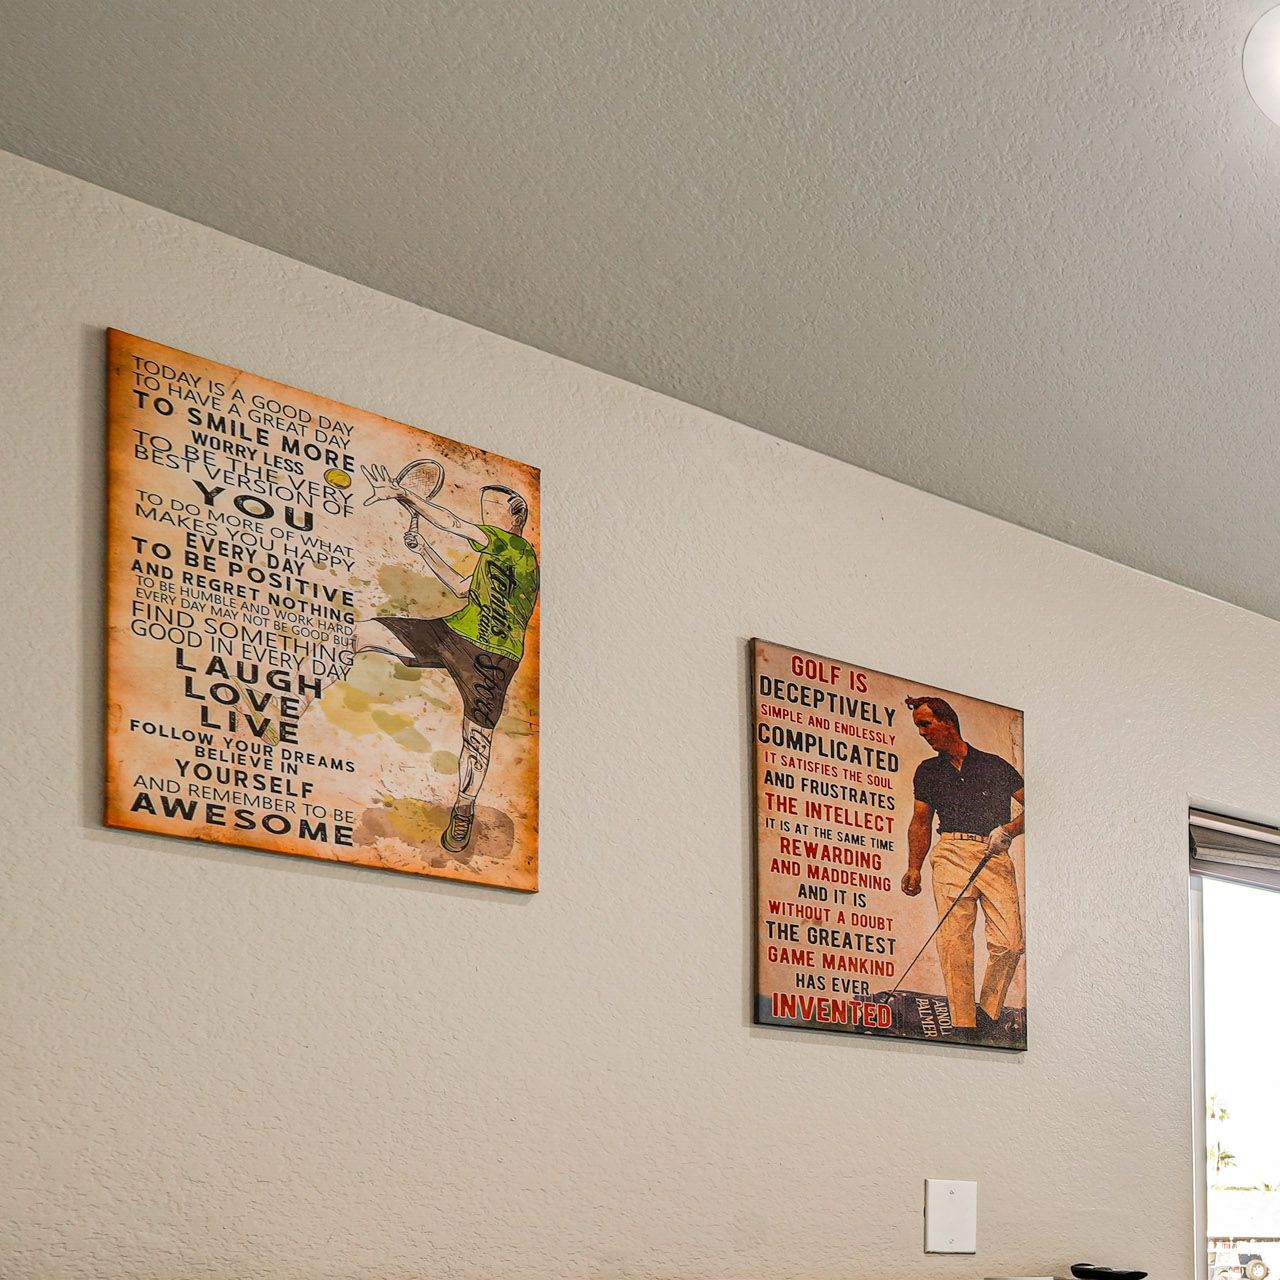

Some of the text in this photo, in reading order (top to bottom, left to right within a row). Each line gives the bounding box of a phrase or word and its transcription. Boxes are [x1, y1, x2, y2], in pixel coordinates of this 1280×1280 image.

[132, 355, 354, 437] TODAY IS A GOOD DAY
[132, 371, 351, 450] TO HAVE A GREAT DAY
[132, 389, 355, 473] TO SMILE MORE
[190, 430, 304, 476] WORRY LESS
[132, 429, 354, 505] TO BE THE VERY
[135, 444, 354, 518] BEST VERSION OF
[136, 489, 354, 558] TO DO MORE OF WHAT
[192, 479, 314, 532] YOU
[136, 503, 355, 572] MAKES YOU HAPPY
[186, 532, 305, 576] EVERY DAY
[131, 536, 354, 607] TO BE POSITIVE
[131, 559, 355, 625] AND REGRET NOTHING
[135, 574, 353, 636] TO BE HUMBLE AND WORK HARD
[136, 587, 356, 647] EVERY DAY MAY NOT BE GOOD BUT
[131, 619, 351, 682] GOOD IN EVERY DAY
[132, 600, 354, 667] FIND SOMETHING
[176, 647, 322, 699] LAUGH
[791, 655, 867, 693] GOLF IS
[185, 676, 299, 720] LOVE
[760, 675, 896, 727] DECEPTIVELY
[130, 719, 355, 773] FOLLOW YOUR DREAMS
[200, 705, 299, 745] LIVE
[758, 722, 899, 773] COMPLICATED
[761, 704, 896, 746] SIMPLE AND ENDLESSLY
[176, 758, 314, 798] YOURSELF
[195, 746, 298, 775] BELIEVE IN
[765, 751, 893, 790] IT SATISFIES THE SOUL
[133, 775, 354, 823] AND REMEMBER TO BE
[764, 770, 895, 810] AND FRUSTRATES
[765, 792, 895, 834] THE INTELLECT
[130, 792, 354, 846] AWESOME
[765, 818, 895, 851] IT IS AT THE SAME TIME
[770, 858, 891, 891] AND MADDENING
[780, 837, 882, 870] REWARDING
[768, 900, 893, 931] WITHOUT A DOUBT
[798, 884, 867, 908] AND IT IS
[766, 920, 896, 955] THE GREATEST
[768, 946, 895, 977] GAME MANKIND
[796, 973, 870, 995] HAS EVER
[772, 993, 892, 1028] INVENTED
[916, 998, 938, 1037] PALMER
